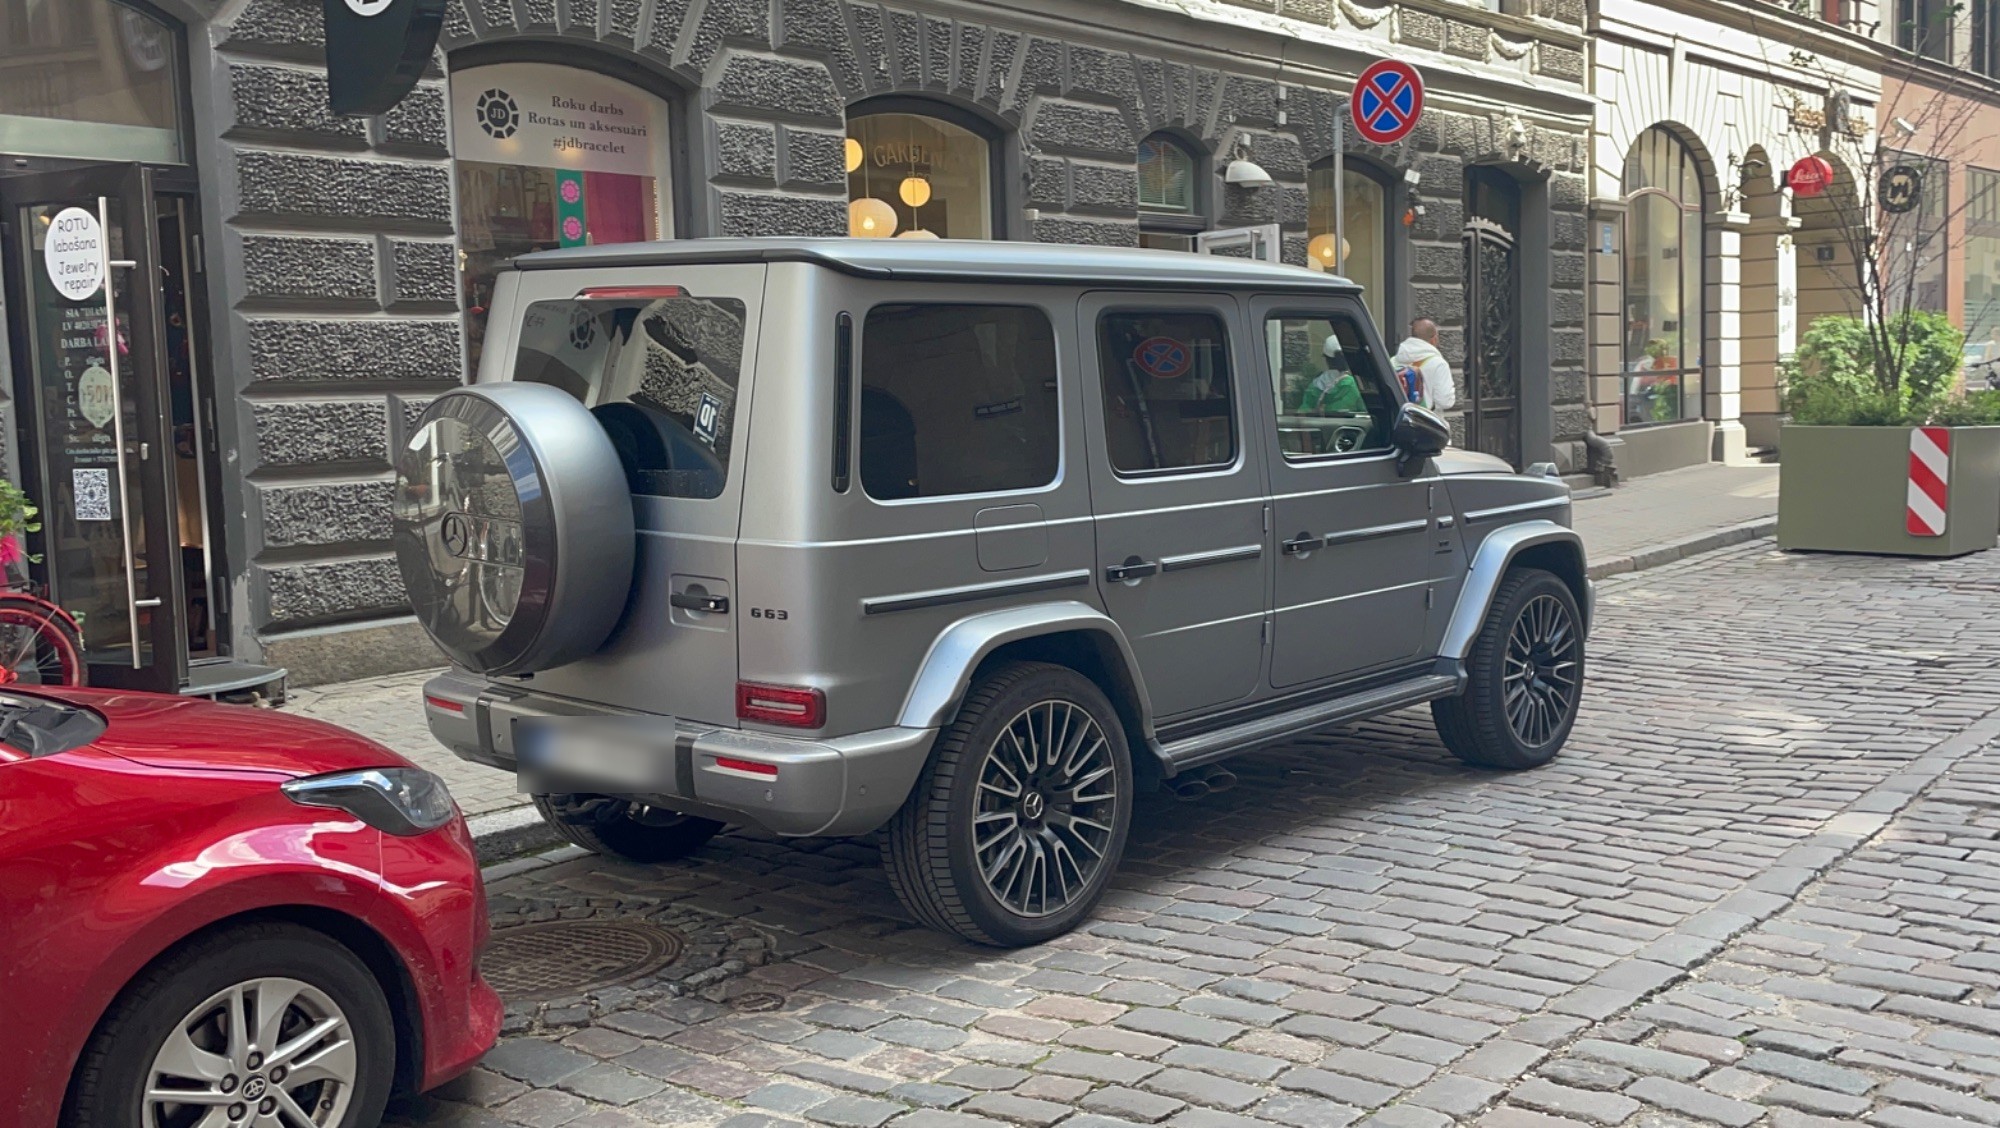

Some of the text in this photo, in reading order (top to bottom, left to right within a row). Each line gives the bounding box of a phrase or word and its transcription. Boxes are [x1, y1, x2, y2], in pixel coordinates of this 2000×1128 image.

[490, 108, 506, 120] JD
[552, 95, 624, 116] Roku darbs
[528, 111, 566, 128] Rotas
[569, 118, 586, 130] un
[553, 136, 626, 154] #jdbracelet
[57, 217, 89, 233] ROTU
[53, 236, 97, 253] labošana
[58, 258, 98, 276] Jewelry
[64, 275, 96, 293] repair
[60, 337, 93, 349] DARBA
